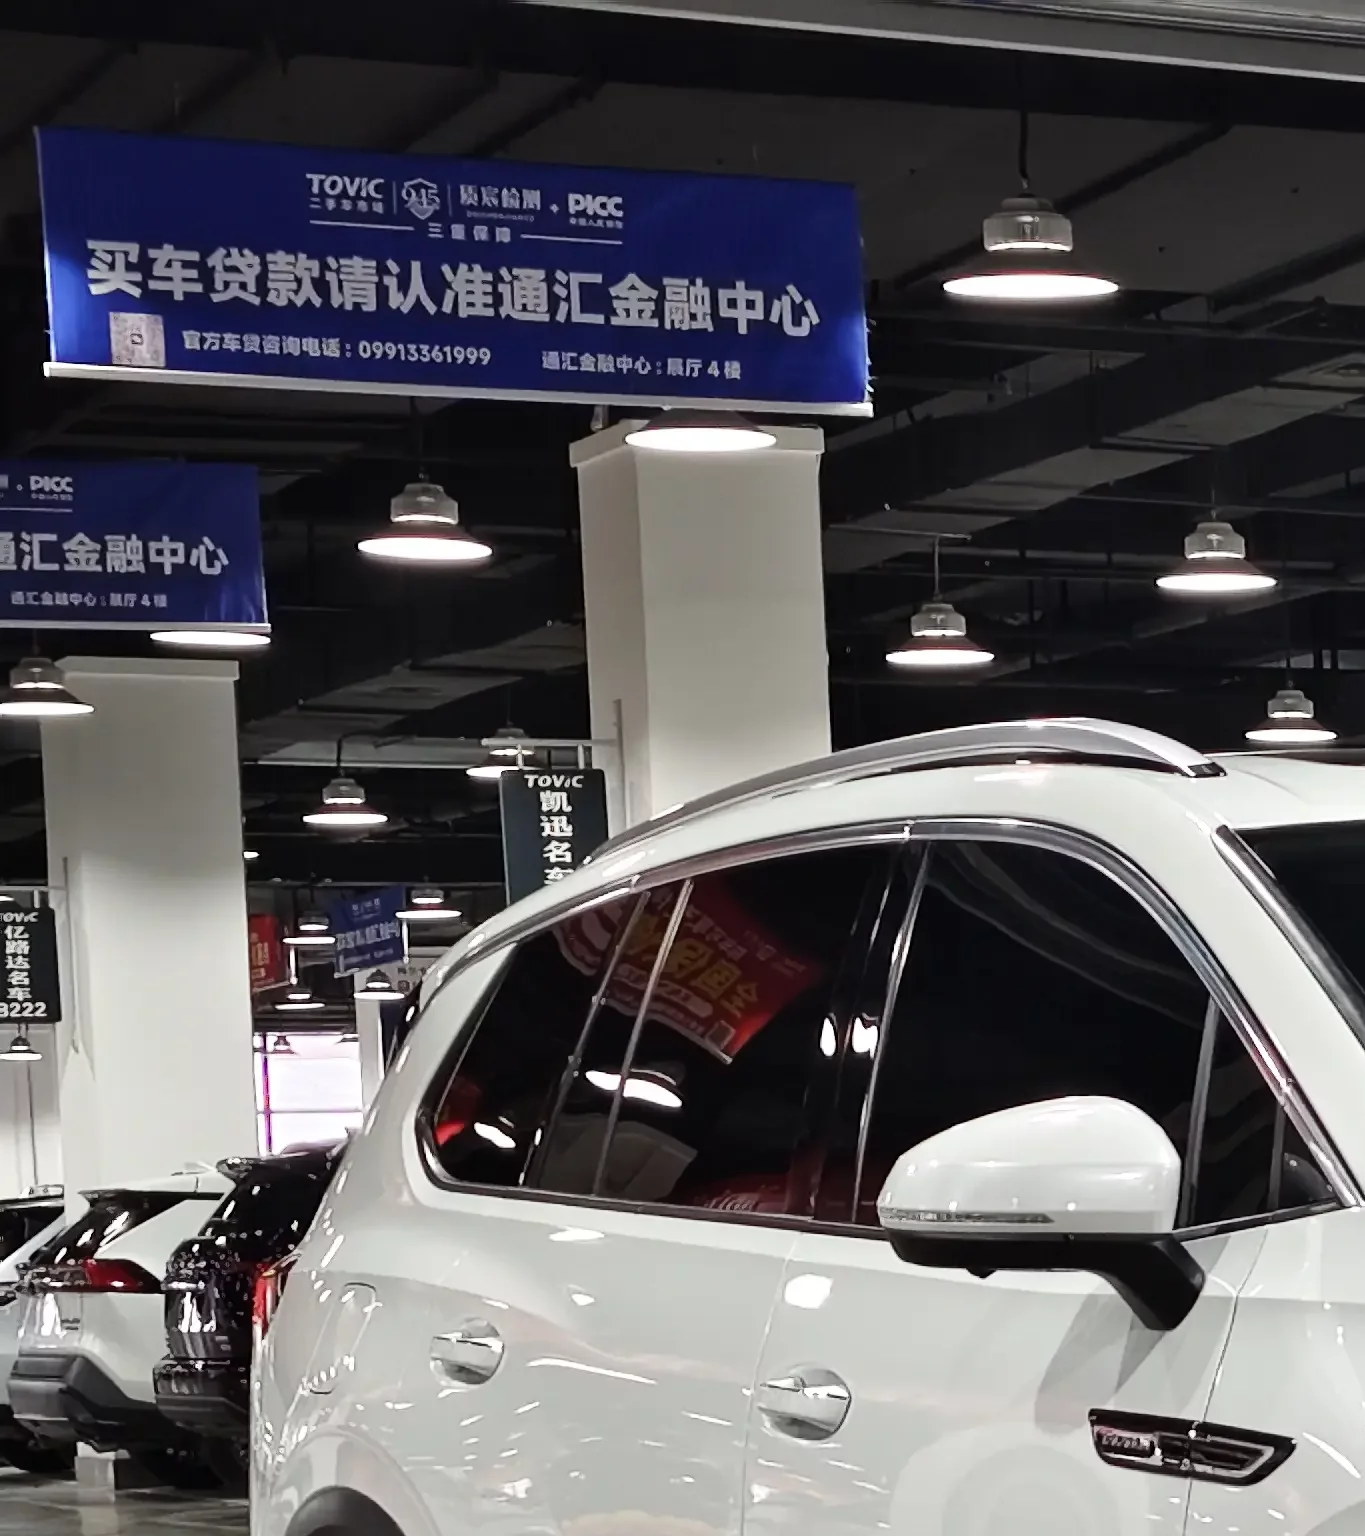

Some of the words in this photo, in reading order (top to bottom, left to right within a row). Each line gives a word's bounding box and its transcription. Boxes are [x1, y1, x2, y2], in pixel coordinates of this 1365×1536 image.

[306, 174, 384, 198] TOVIC
[568, 193, 624, 217] PICC
[86, 239, 820, 338] 买车贷款请认准通汇金融中心
[30, 475, 74, 493] PICC
[524, 773, 585, 788] TOVIC
[0, 912, 39, 923] OVIC
